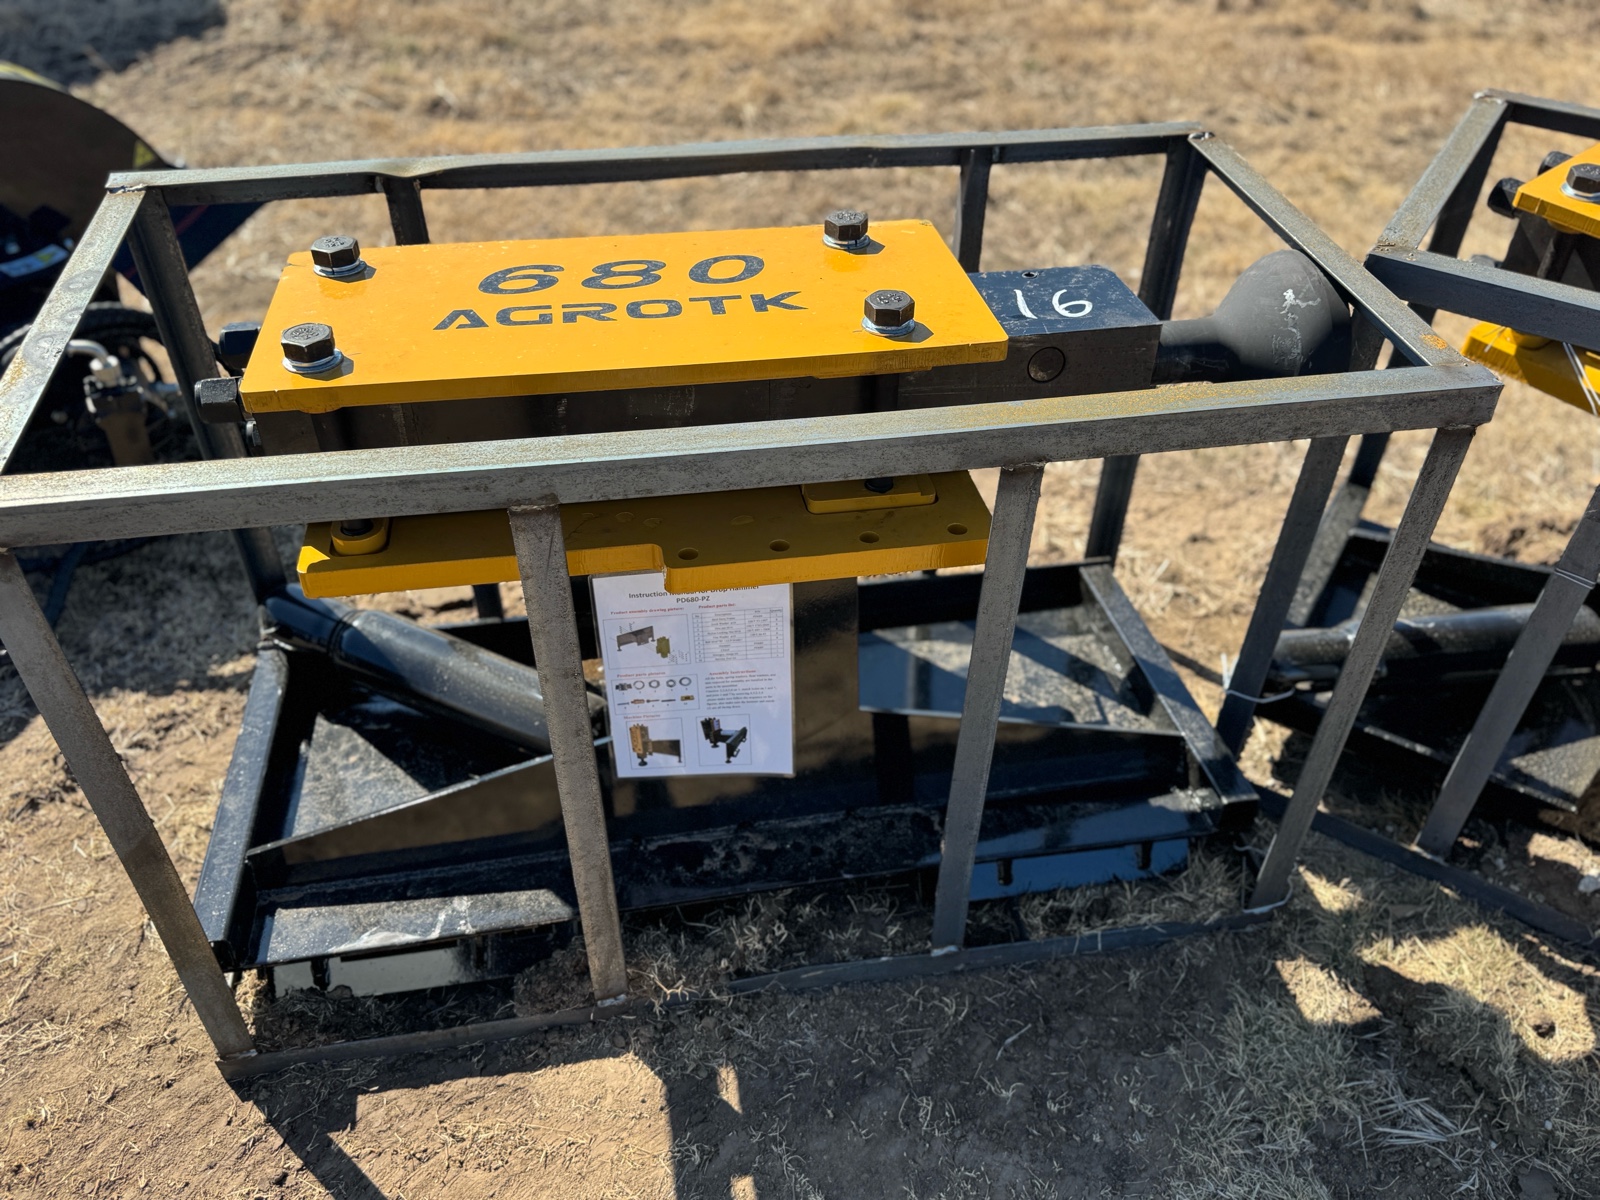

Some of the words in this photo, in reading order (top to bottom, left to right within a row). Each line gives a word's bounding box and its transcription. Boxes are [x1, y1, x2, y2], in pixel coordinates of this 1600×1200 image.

[478, 254, 765, 295] 680
[432, 291, 809, 331] AGROTK
[1013, 288, 1093, 319] 16
[628, 591, 668, 599] Instruction
[676, 595, 711, 604] PD680-PZ
